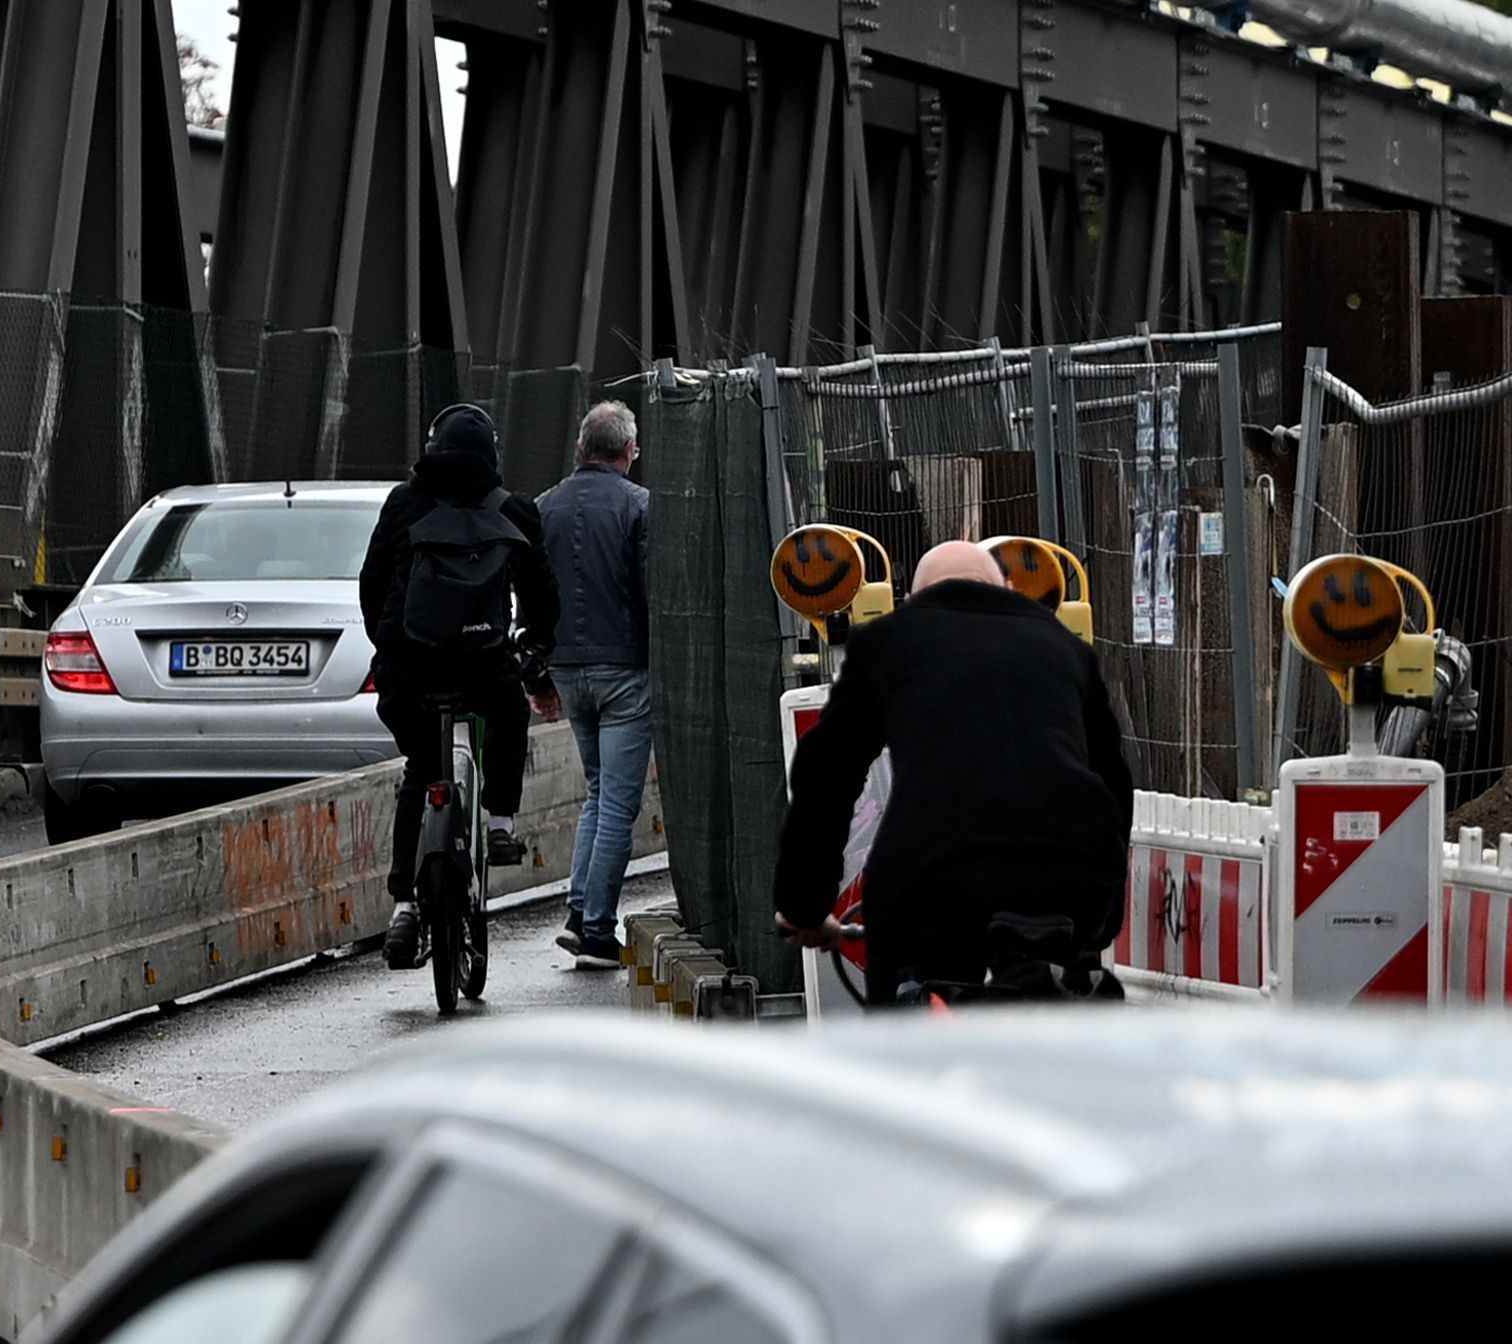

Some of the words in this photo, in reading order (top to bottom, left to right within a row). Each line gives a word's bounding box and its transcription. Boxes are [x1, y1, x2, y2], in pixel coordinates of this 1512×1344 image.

[185, 645, 200, 667] B
[214, 645, 244, 667] BQ
[248, 644, 304, 667] 3454
